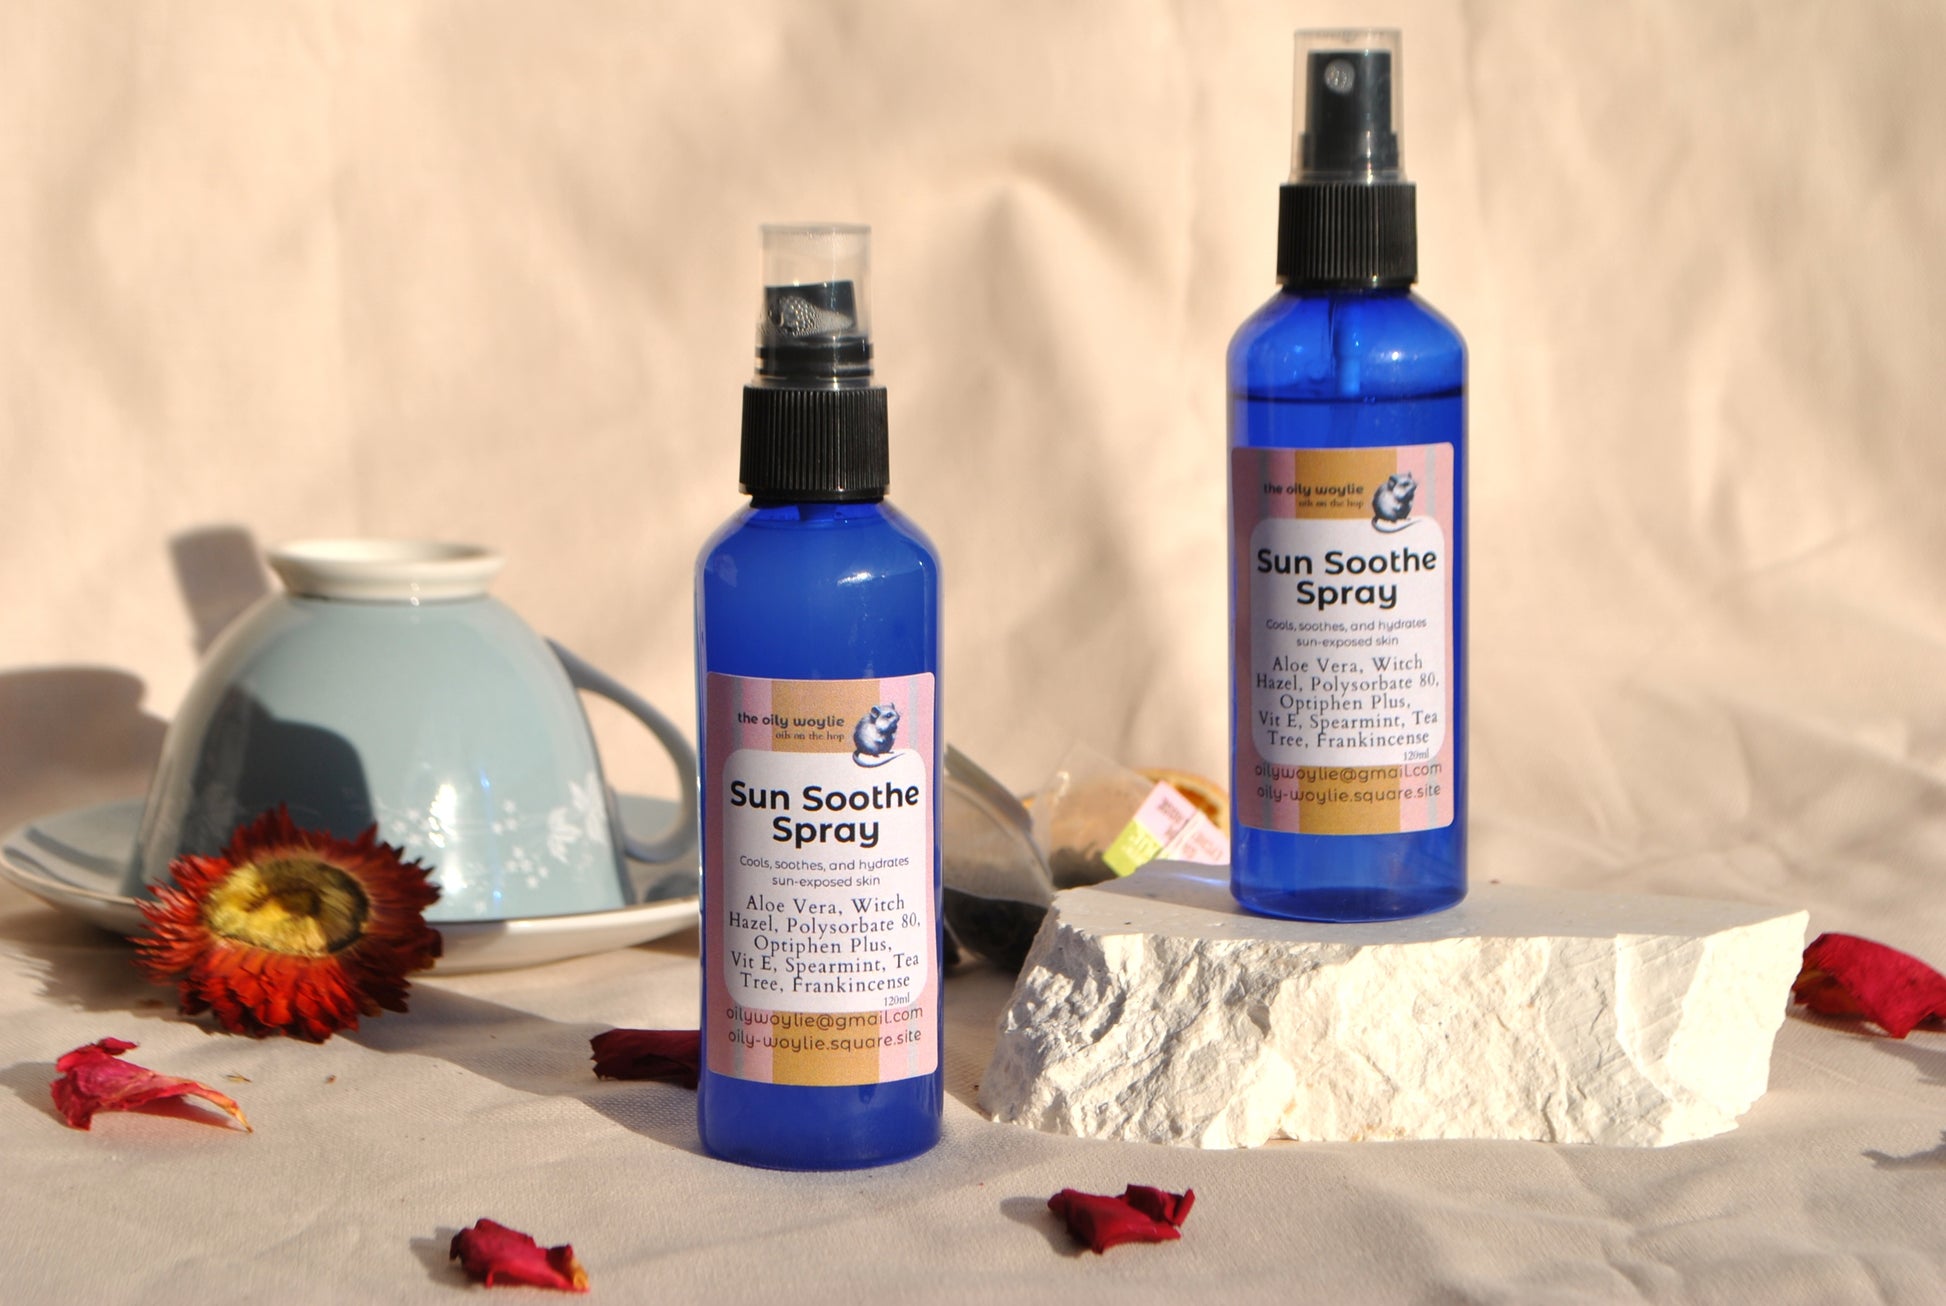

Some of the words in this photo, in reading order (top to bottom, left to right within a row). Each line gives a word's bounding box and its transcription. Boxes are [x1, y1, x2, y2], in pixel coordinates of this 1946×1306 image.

[1263, 483, 1283, 495] the
[1286, 483, 1312, 496] oily
[1315, 483, 1364, 496] woylie
[1257, 549, 1313, 575] Sun
[1325, 547, 1437, 575] Soothe
[1297, 581, 1397, 611] Spray
[1266, 619, 1297, 632] Cools,
[1298, 620, 1347, 633] soothes,
[1350, 619, 1375, 631] and
[1378, 618, 1427, 632] hydrates
[1296, 636, 1373, 648] sun-exposed
[1376, 635, 1399, 646] skin
[1272, 656, 1309, 673] Aloe
[1317, 658, 1364, 674] Vera,
[1372, 653, 1423, 671] Witch
[1256, 674, 1303, 692] Hazel,
[1311, 674, 1413, 697] Polysorbate
[1279, 693, 1363, 715] Optiphen
[1371, 692, 1411, 709] Plus,
[738, 712, 758, 725] the
[762, 715, 789, 729] oily
[793, 715, 845, 729] woylie
[1258, 710, 1280, 728] Vit
[1287, 714, 1303, 730] E,
[1310, 712, 1405, 735] Spearmint,
[1412, 710, 1438, 726] Tea
[775, 731, 791, 740] oils
[809, 731, 824, 740] the
[827, 731, 845, 742] hop
[1267, 730, 1309, 748] Tree,
[1317, 729, 1429, 748] Frankincense
[1403, 749, 1430, 761] 120ml
[1255, 763, 1442, 784] oilywoylie@gmail.com
[730, 780, 790, 810] Sun
[802, 782, 919, 812] Soothe
[1257, 783, 1441, 804] oily-woylie.square.site
[772, 816, 879, 849] Spray
[739, 855, 772, 870] Cools,
[775, 858, 826, 871] soothes,
[830, 859, 855, 871] and
[859, 856, 909, 871] hydrates
[772, 876, 852, 888] sun-exposed
[856, 875, 881, 886] skin
[746, 895, 785, 913] Aloe
[793, 898, 843, 916] Vera,
[851, 894, 905, 913] Witch
[729, 911, 778, 933] Hazel,
[787, 915, 894, 940] Polysorbate
[754, 934, 841, 958] Optiphen
[850, 936, 892, 953] Plus,
[731, 951, 754, 969] Vit
[762, 955, 777, 973] E,
[785, 956, 886, 979] Spearmint,
[893, 953, 919, 969] Tea
[740, 972, 784, 992] Tree,
[792, 975, 910, 993] Frankincense
[884, 992, 910, 1006] 120ml
[726, 1006, 923, 1031] oilywoylie@gmail.com
[728, 1028, 922, 1052] oily-woylie.square.site
